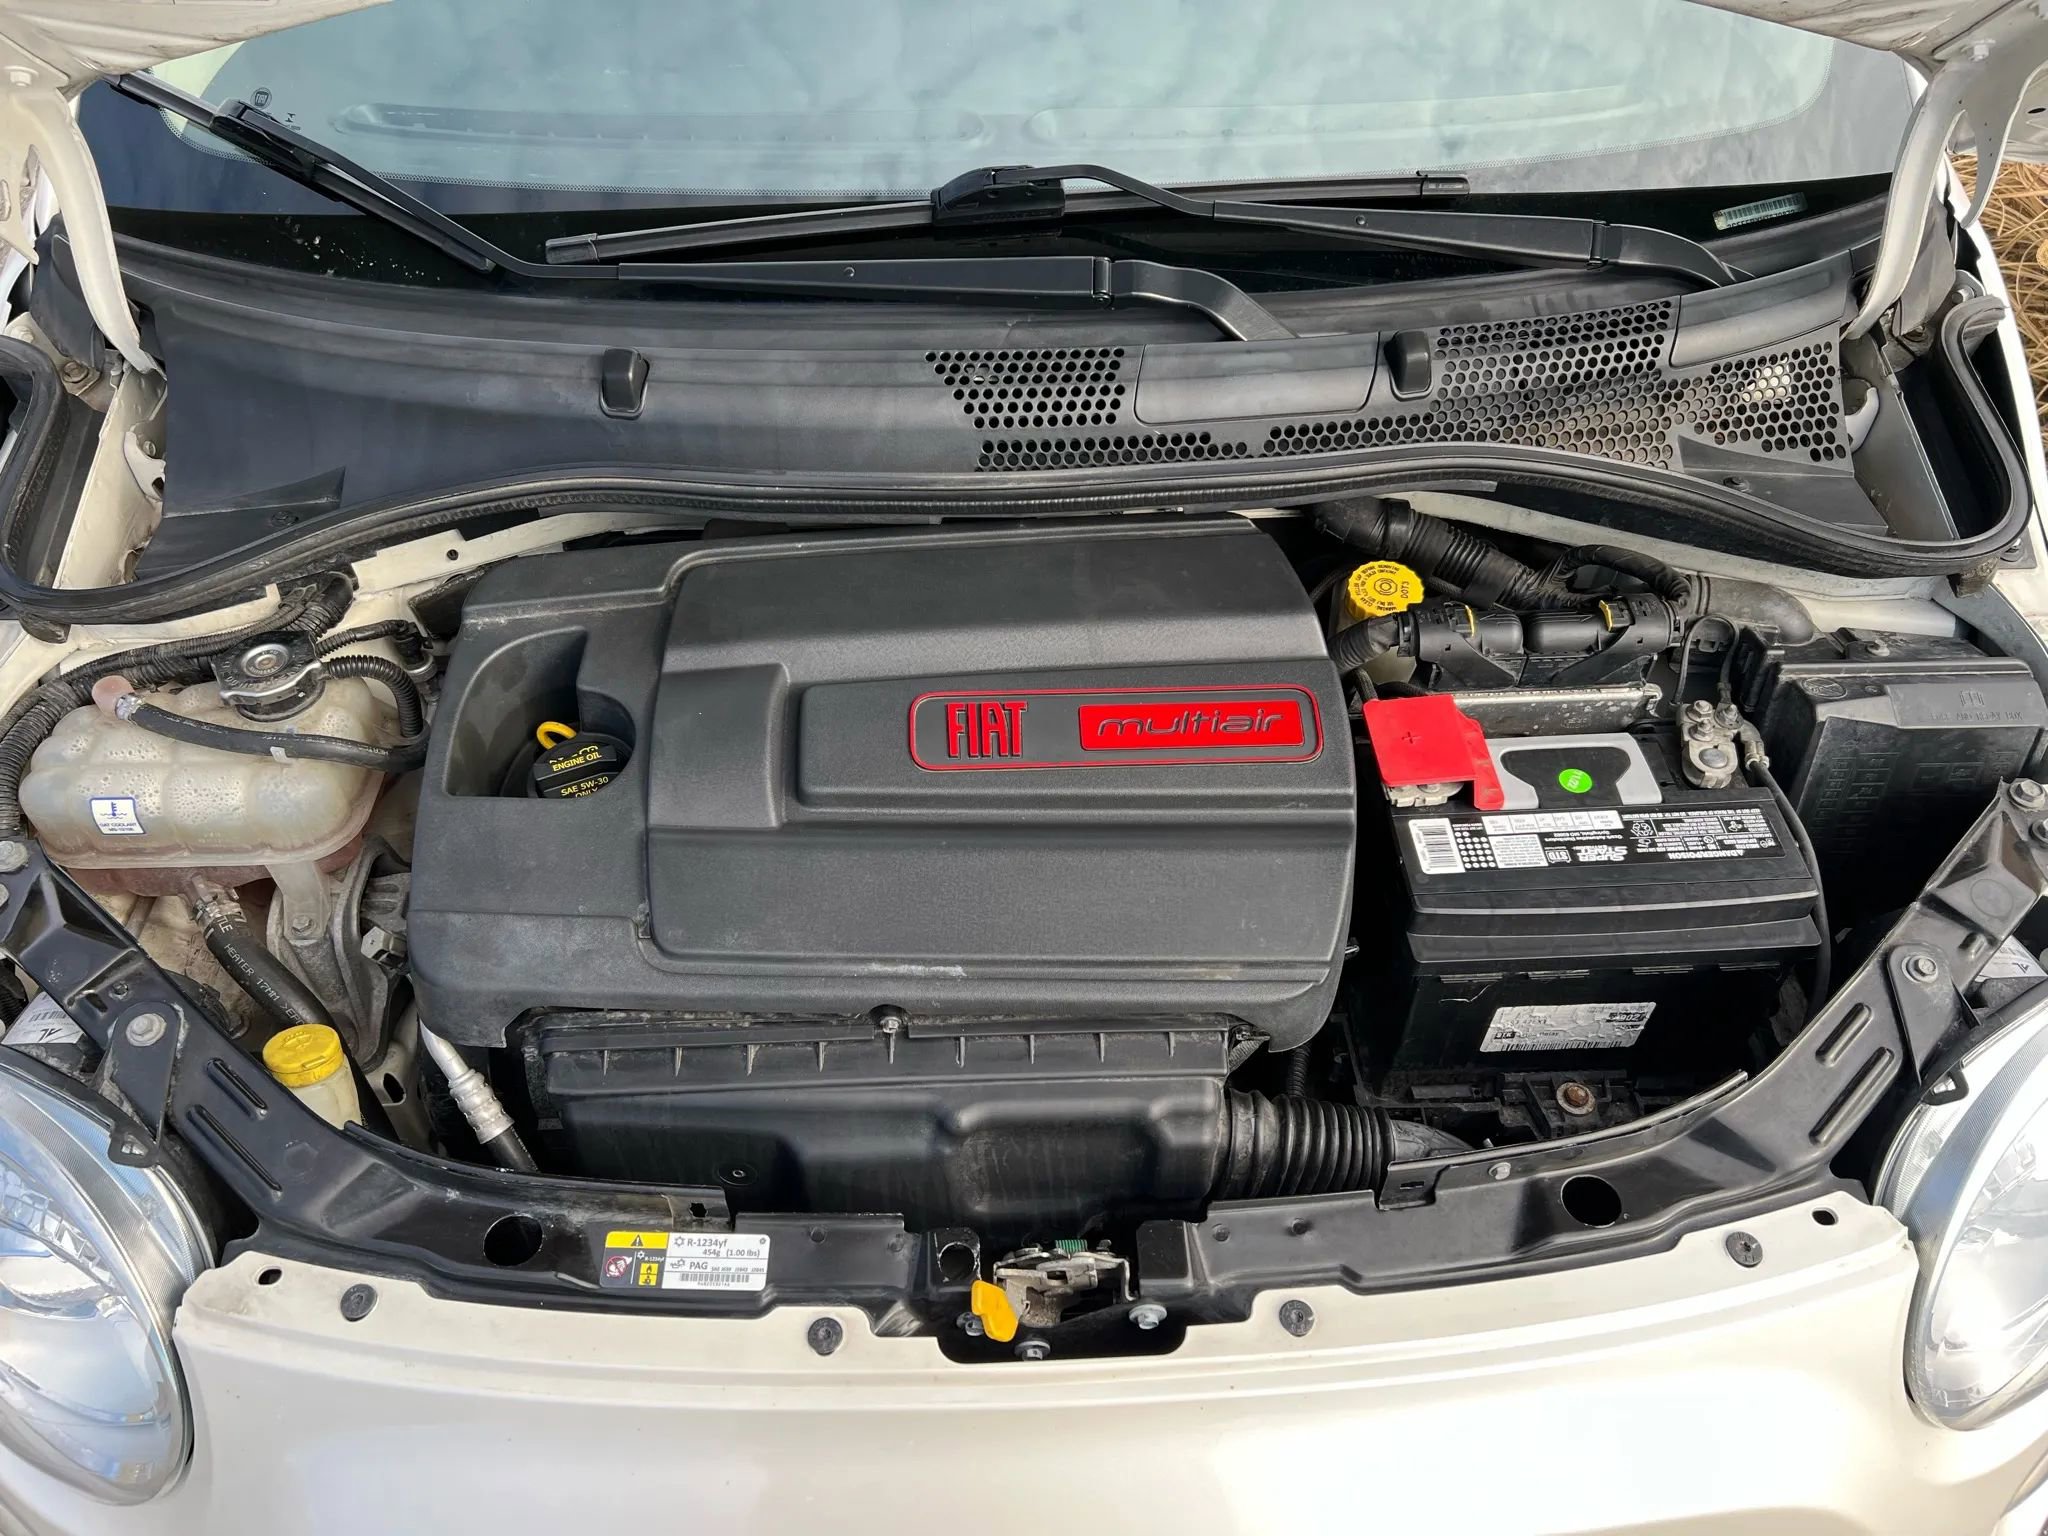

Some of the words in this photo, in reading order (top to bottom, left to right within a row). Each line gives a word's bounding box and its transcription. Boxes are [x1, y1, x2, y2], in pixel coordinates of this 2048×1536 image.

[946, 701, 1028, 758] FIAT
[1097, 708, 1283, 737] multiair
[552, 756, 586, 772] ENGINE
[586, 751, 602, 761] OIL
[561, 785, 578, 796] SAE
[580, 776, 609, 791] 5W-30
[1577, 846, 1628, 856] START
[1579, 854, 1624, 862] SUPER
[224, 943, 254, 977] HEATER
[687, 1238, 728, 1249] R-1234yf
[702, 1249, 721, 1257] 454g
[726, 1249, 746, 1258] (1.00
[747, 1249, 760, 1258] lbs)
[690, 1262, 708, 1270] PAG
